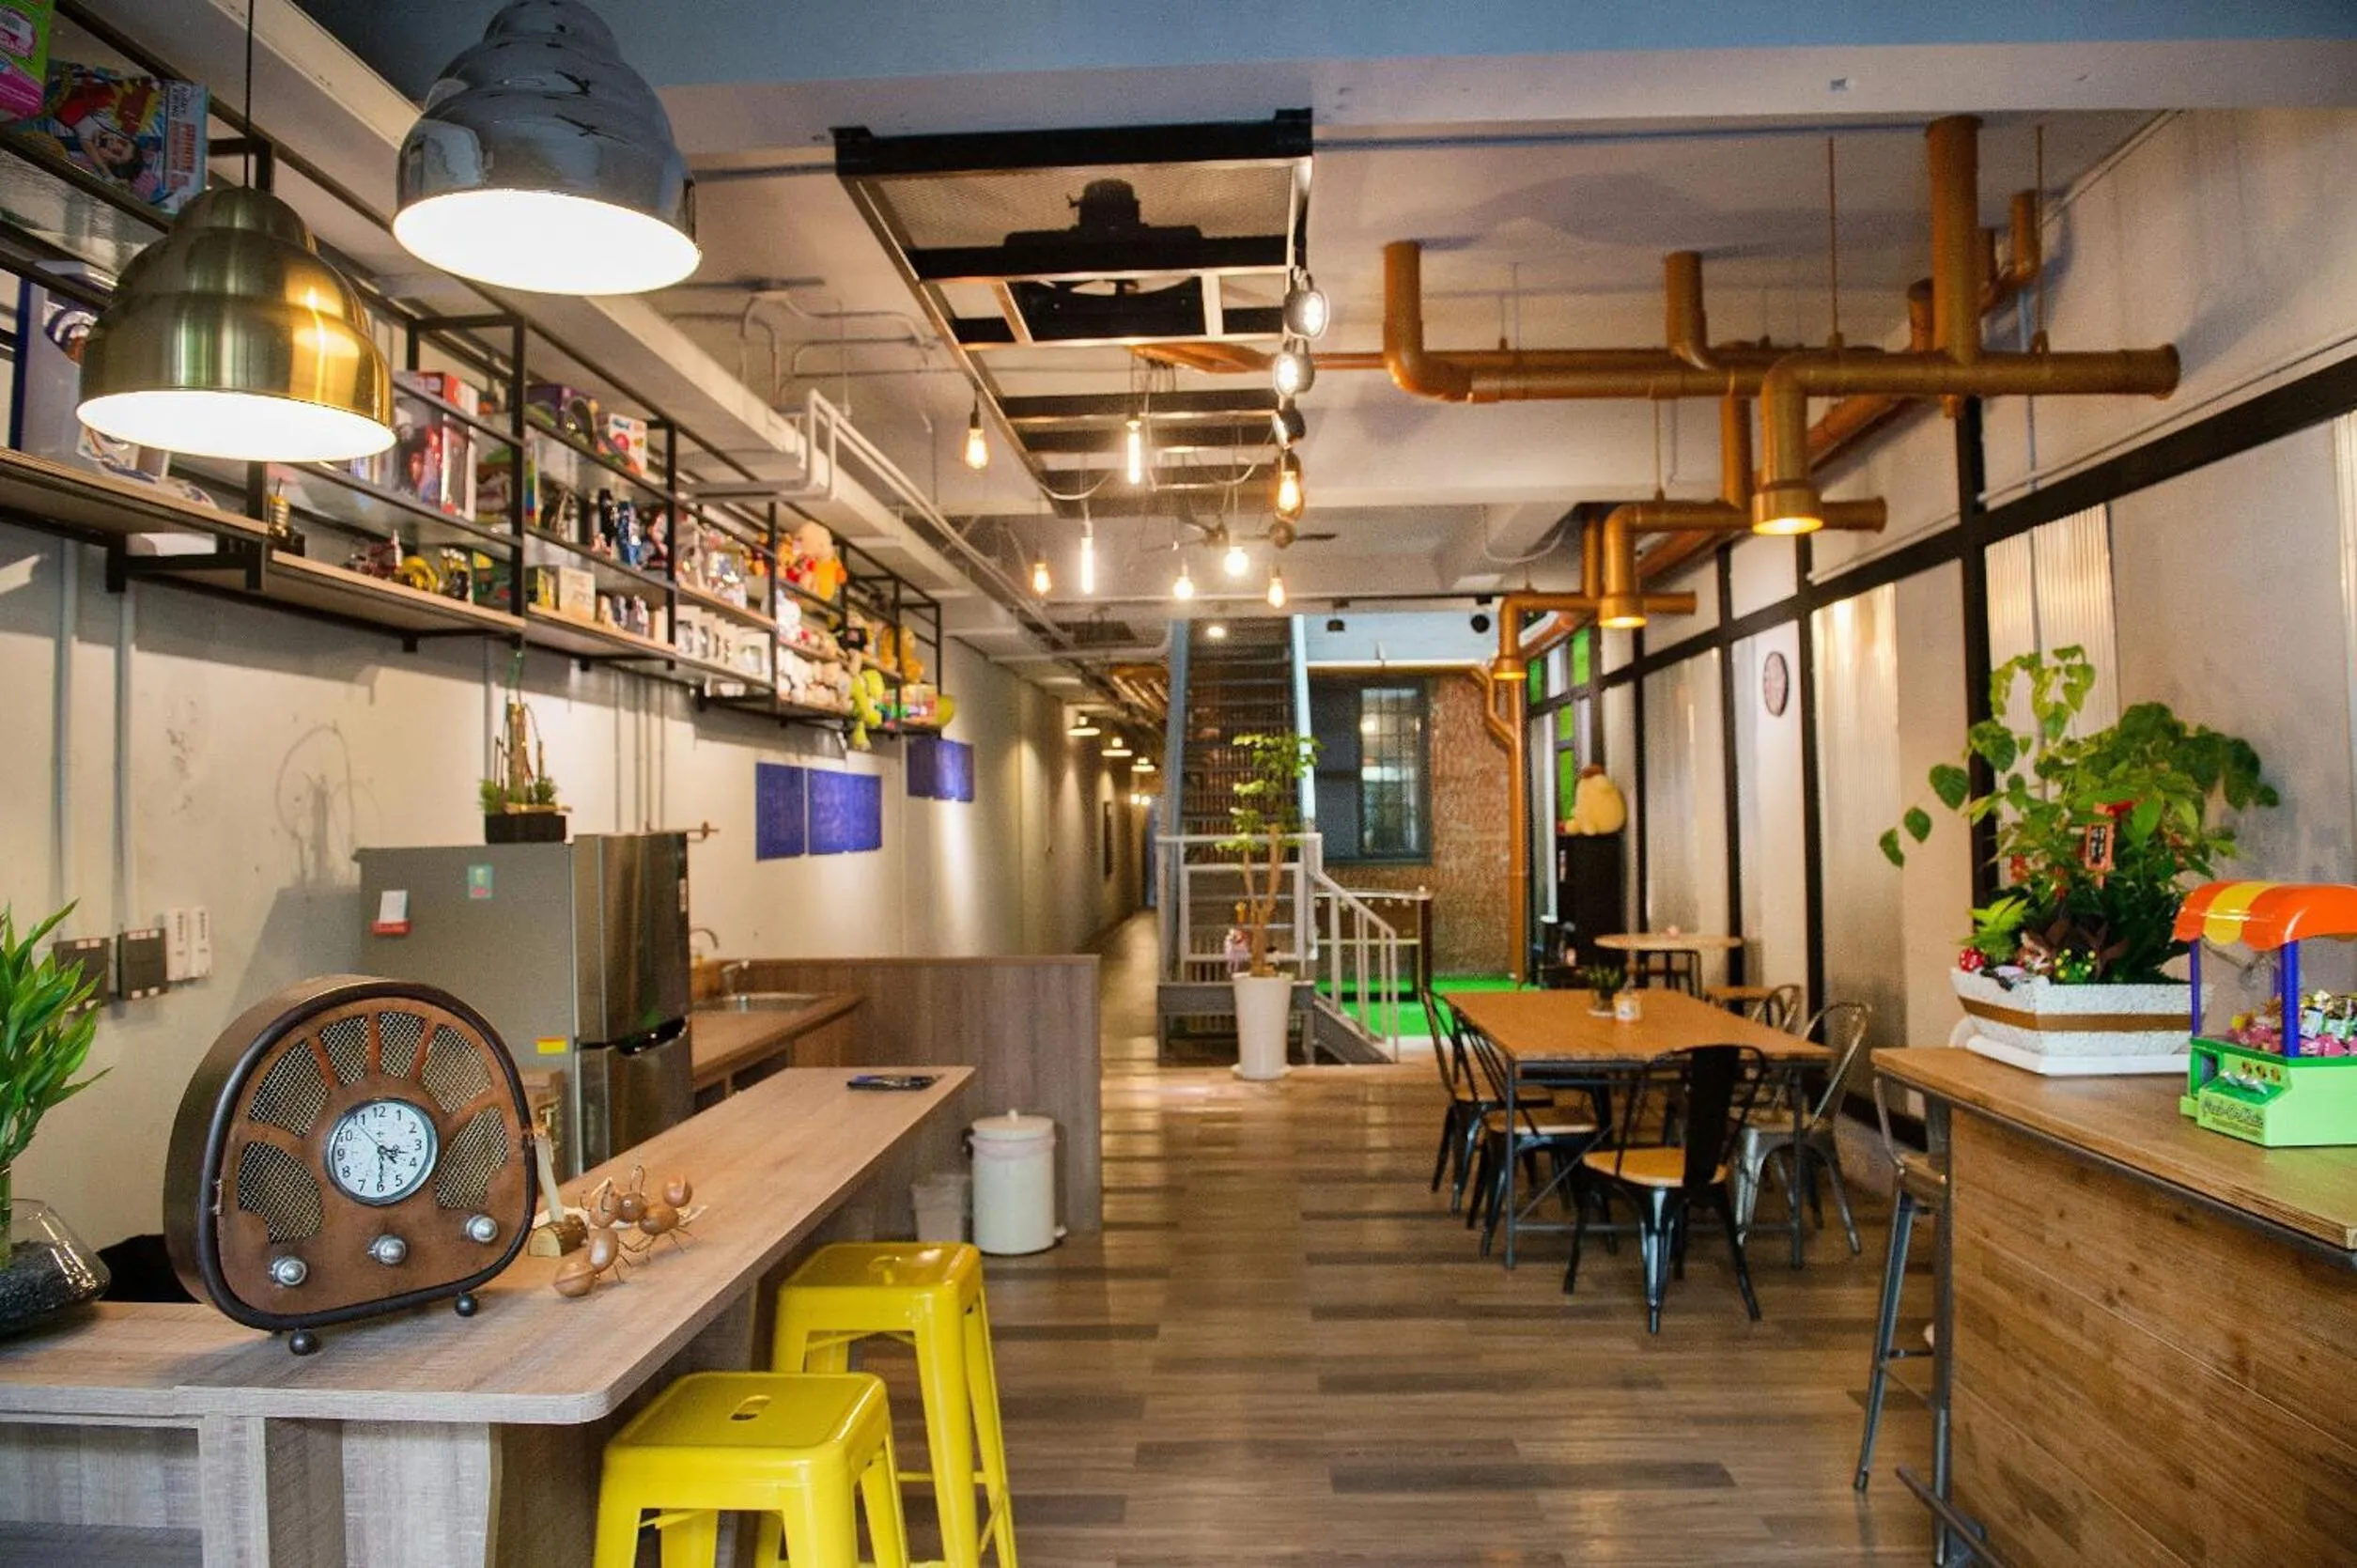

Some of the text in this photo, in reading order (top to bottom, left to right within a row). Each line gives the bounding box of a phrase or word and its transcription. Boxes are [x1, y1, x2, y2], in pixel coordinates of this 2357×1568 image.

[373, 1106, 386, 1118] 12
[353, 1114, 365, 1126] 11
[409, 1122, 417, 1134] 2
[339, 1130, 353, 1142] 10
[414, 1139, 422, 1151] 3
[337, 1148, 345, 1161] 9
[409, 1157, 417, 1168] 4
[342, 1166, 350, 1178] 8
[358, 1179, 365, 1192] 7
[377, 1180, 384, 1192] 6
[395, 1174, 403, 1187] 5
